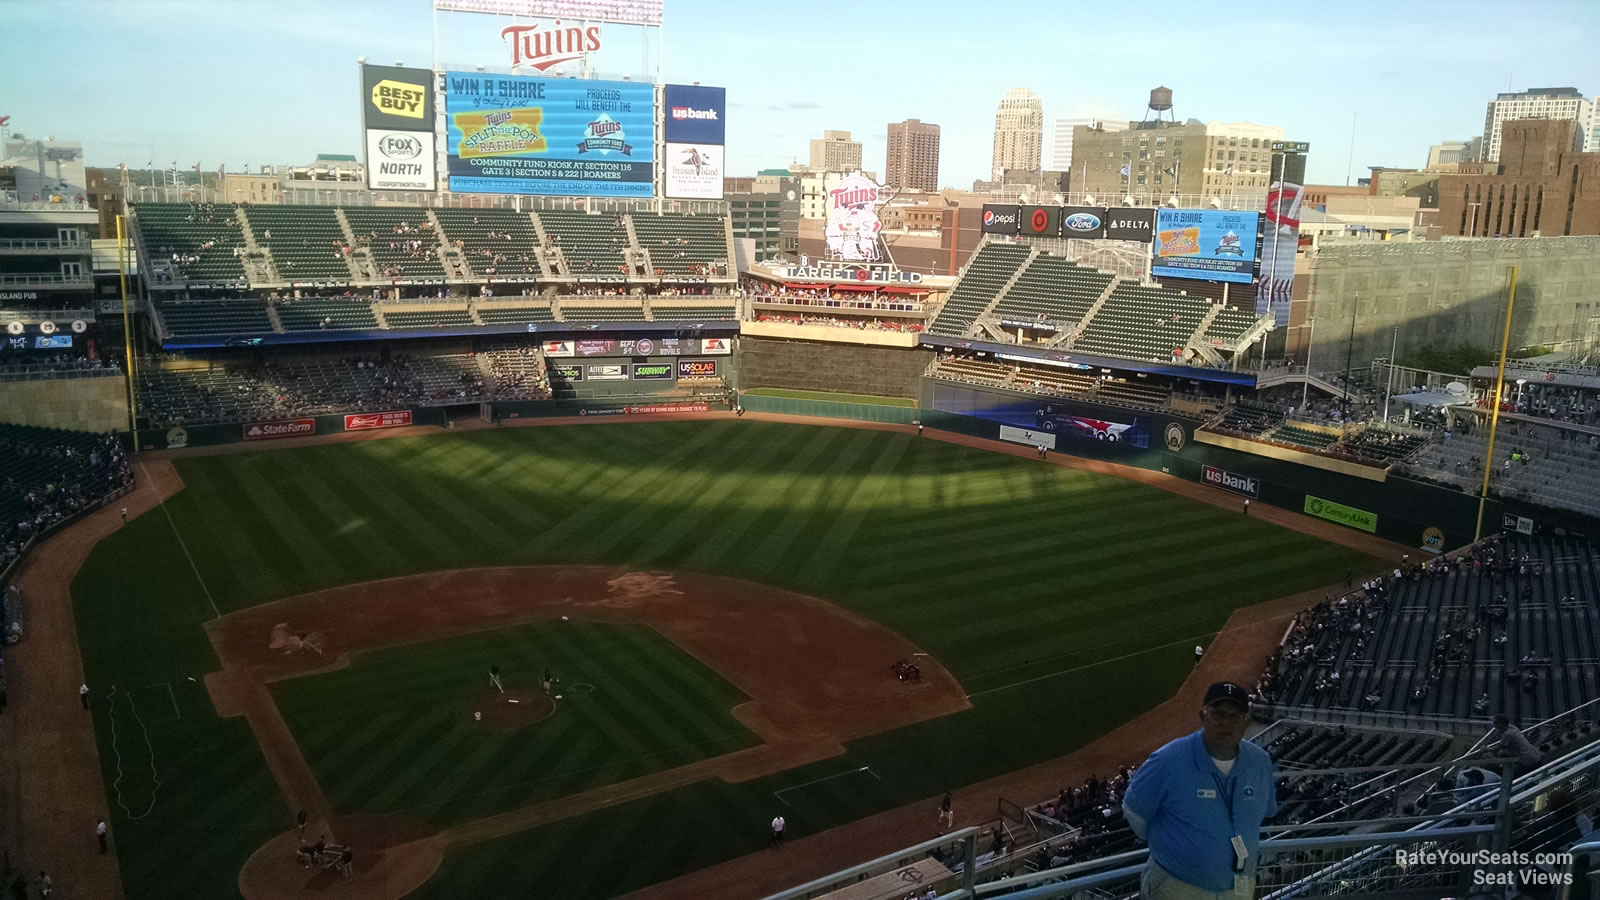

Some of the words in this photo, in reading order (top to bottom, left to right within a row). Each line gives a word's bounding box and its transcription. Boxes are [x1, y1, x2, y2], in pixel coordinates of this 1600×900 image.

[501, 19, 600, 69] Twins
[379, 86, 423, 102] BEST
[451, 78, 479, 96] WIN
[485, 80, 494, 96] A
[499, 80, 546, 99] SHARE
[586, 88, 620, 100] PROCEEDS
[381, 97, 419, 112] BUY
[576, 100, 590, 110] WILL
[592, 101, 617, 112] BENEFIT
[620, 102, 632, 112] THE
[484, 112, 512, 126] Twins
[588, 120, 621, 137] Twins
[465, 126, 497, 148] SPLIT
[512, 126, 538, 143] POT
[387, 138, 412, 150] FOX
[480, 140, 526, 152] RAFFLE
[380, 162, 422, 176] NORTH
[470, 158, 522, 167] COMMUNITY
[548, 161, 572, 169] KIOSK
[515, 168, 550, 176] SECTION
[830, 186, 877, 208] Twins
[994, 214, 1016, 224] pepsi
[1072, 216, 1093, 228] Ford
[1160, 212, 1172, 222] WIN
[1174, 212, 1180, 222] A
[1180, 212, 1203, 223] SHARE
[1120, 220, 1150, 229] DELTA
[802, 256, 808, 266] B
[788, 266, 854, 280] TARGET
[872, 270, 922, 283] FIELD
[635, 366, 670, 375] SUBWAY
[1325, 506, 1370, 526] CenturyLink
